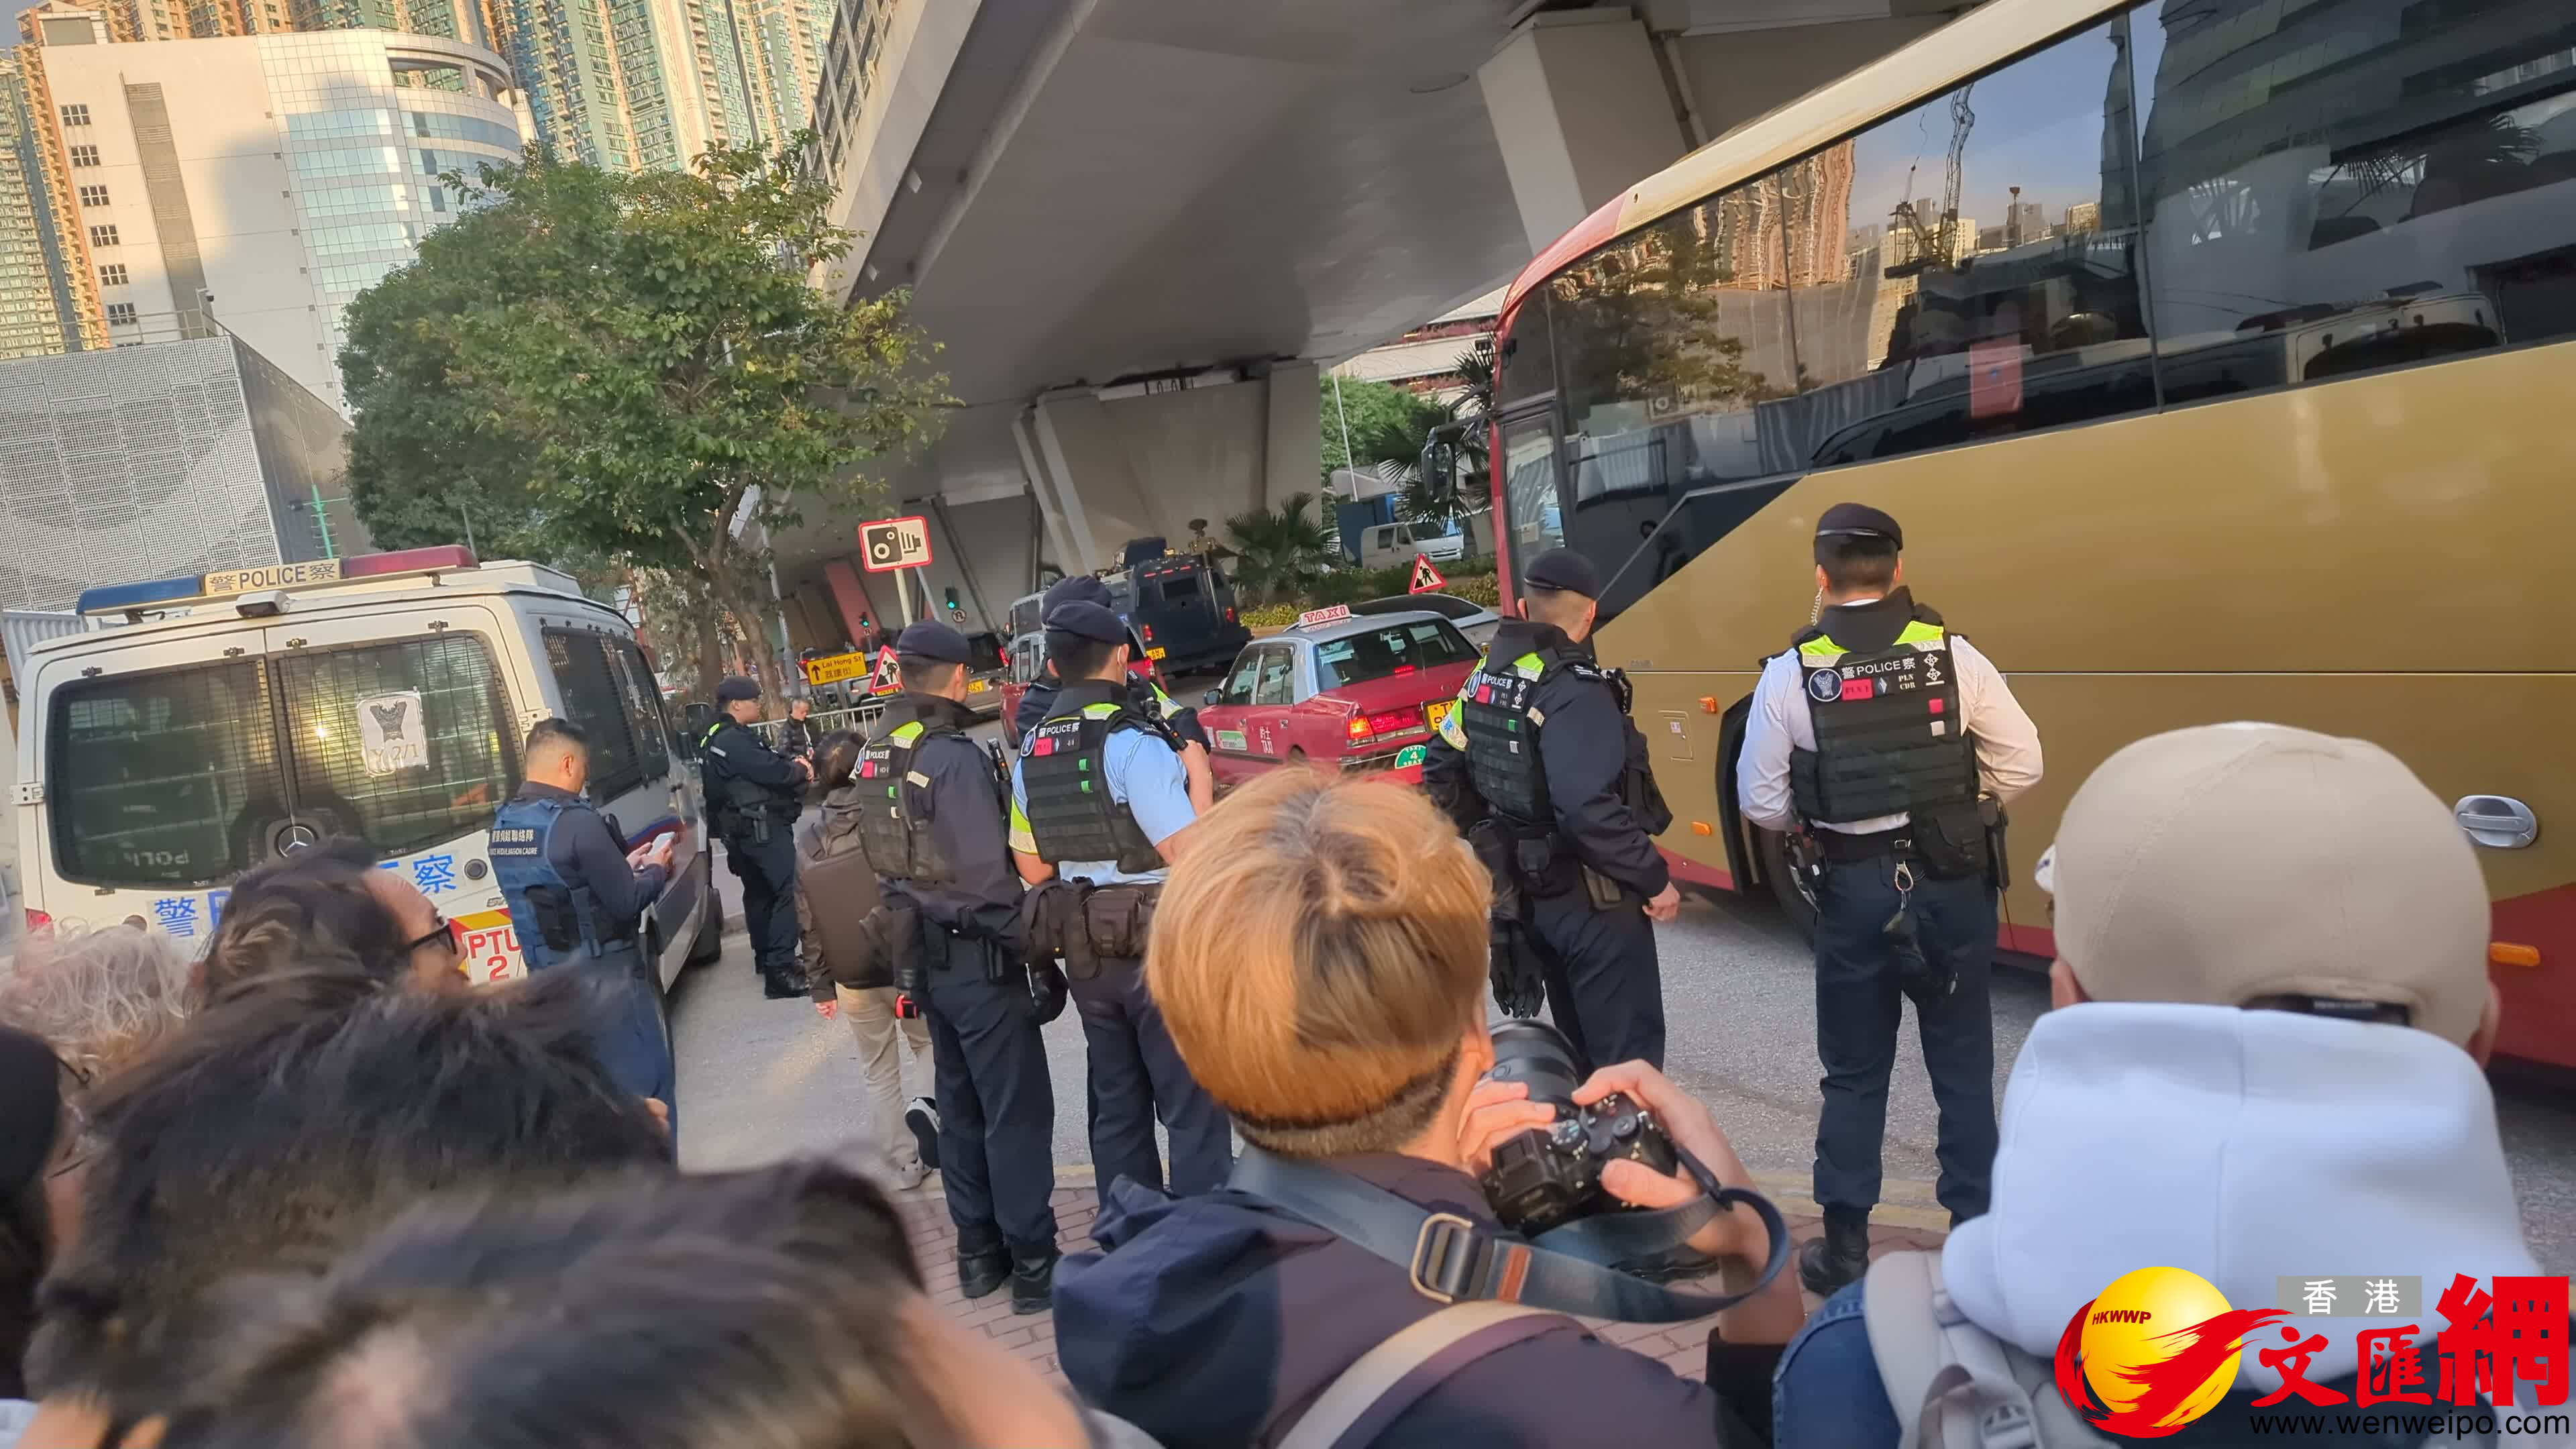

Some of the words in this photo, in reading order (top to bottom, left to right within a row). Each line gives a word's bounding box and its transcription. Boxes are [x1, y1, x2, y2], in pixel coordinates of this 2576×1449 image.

[209, 575, 235, 592] 警
[239, 566, 307, 589] POLICE
[309, 564, 335, 580] 察
[1305, 606, 1346, 623] TAXI
[1857, 660, 1901, 676] POLICE
[1487, 676, 1507, 687] POLICE
[1046, 724, 1071, 735] POLICE
[392, 743, 419, 761] 2/1
[870, 751, 885, 759] POLICE
[1410, 751, 1417, 759] 4
[413, 855, 456, 894] 察
[154, 897, 199, 938] 警
[469, 929, 521, 959] PTU
[487, 955, 509, 982] 2
